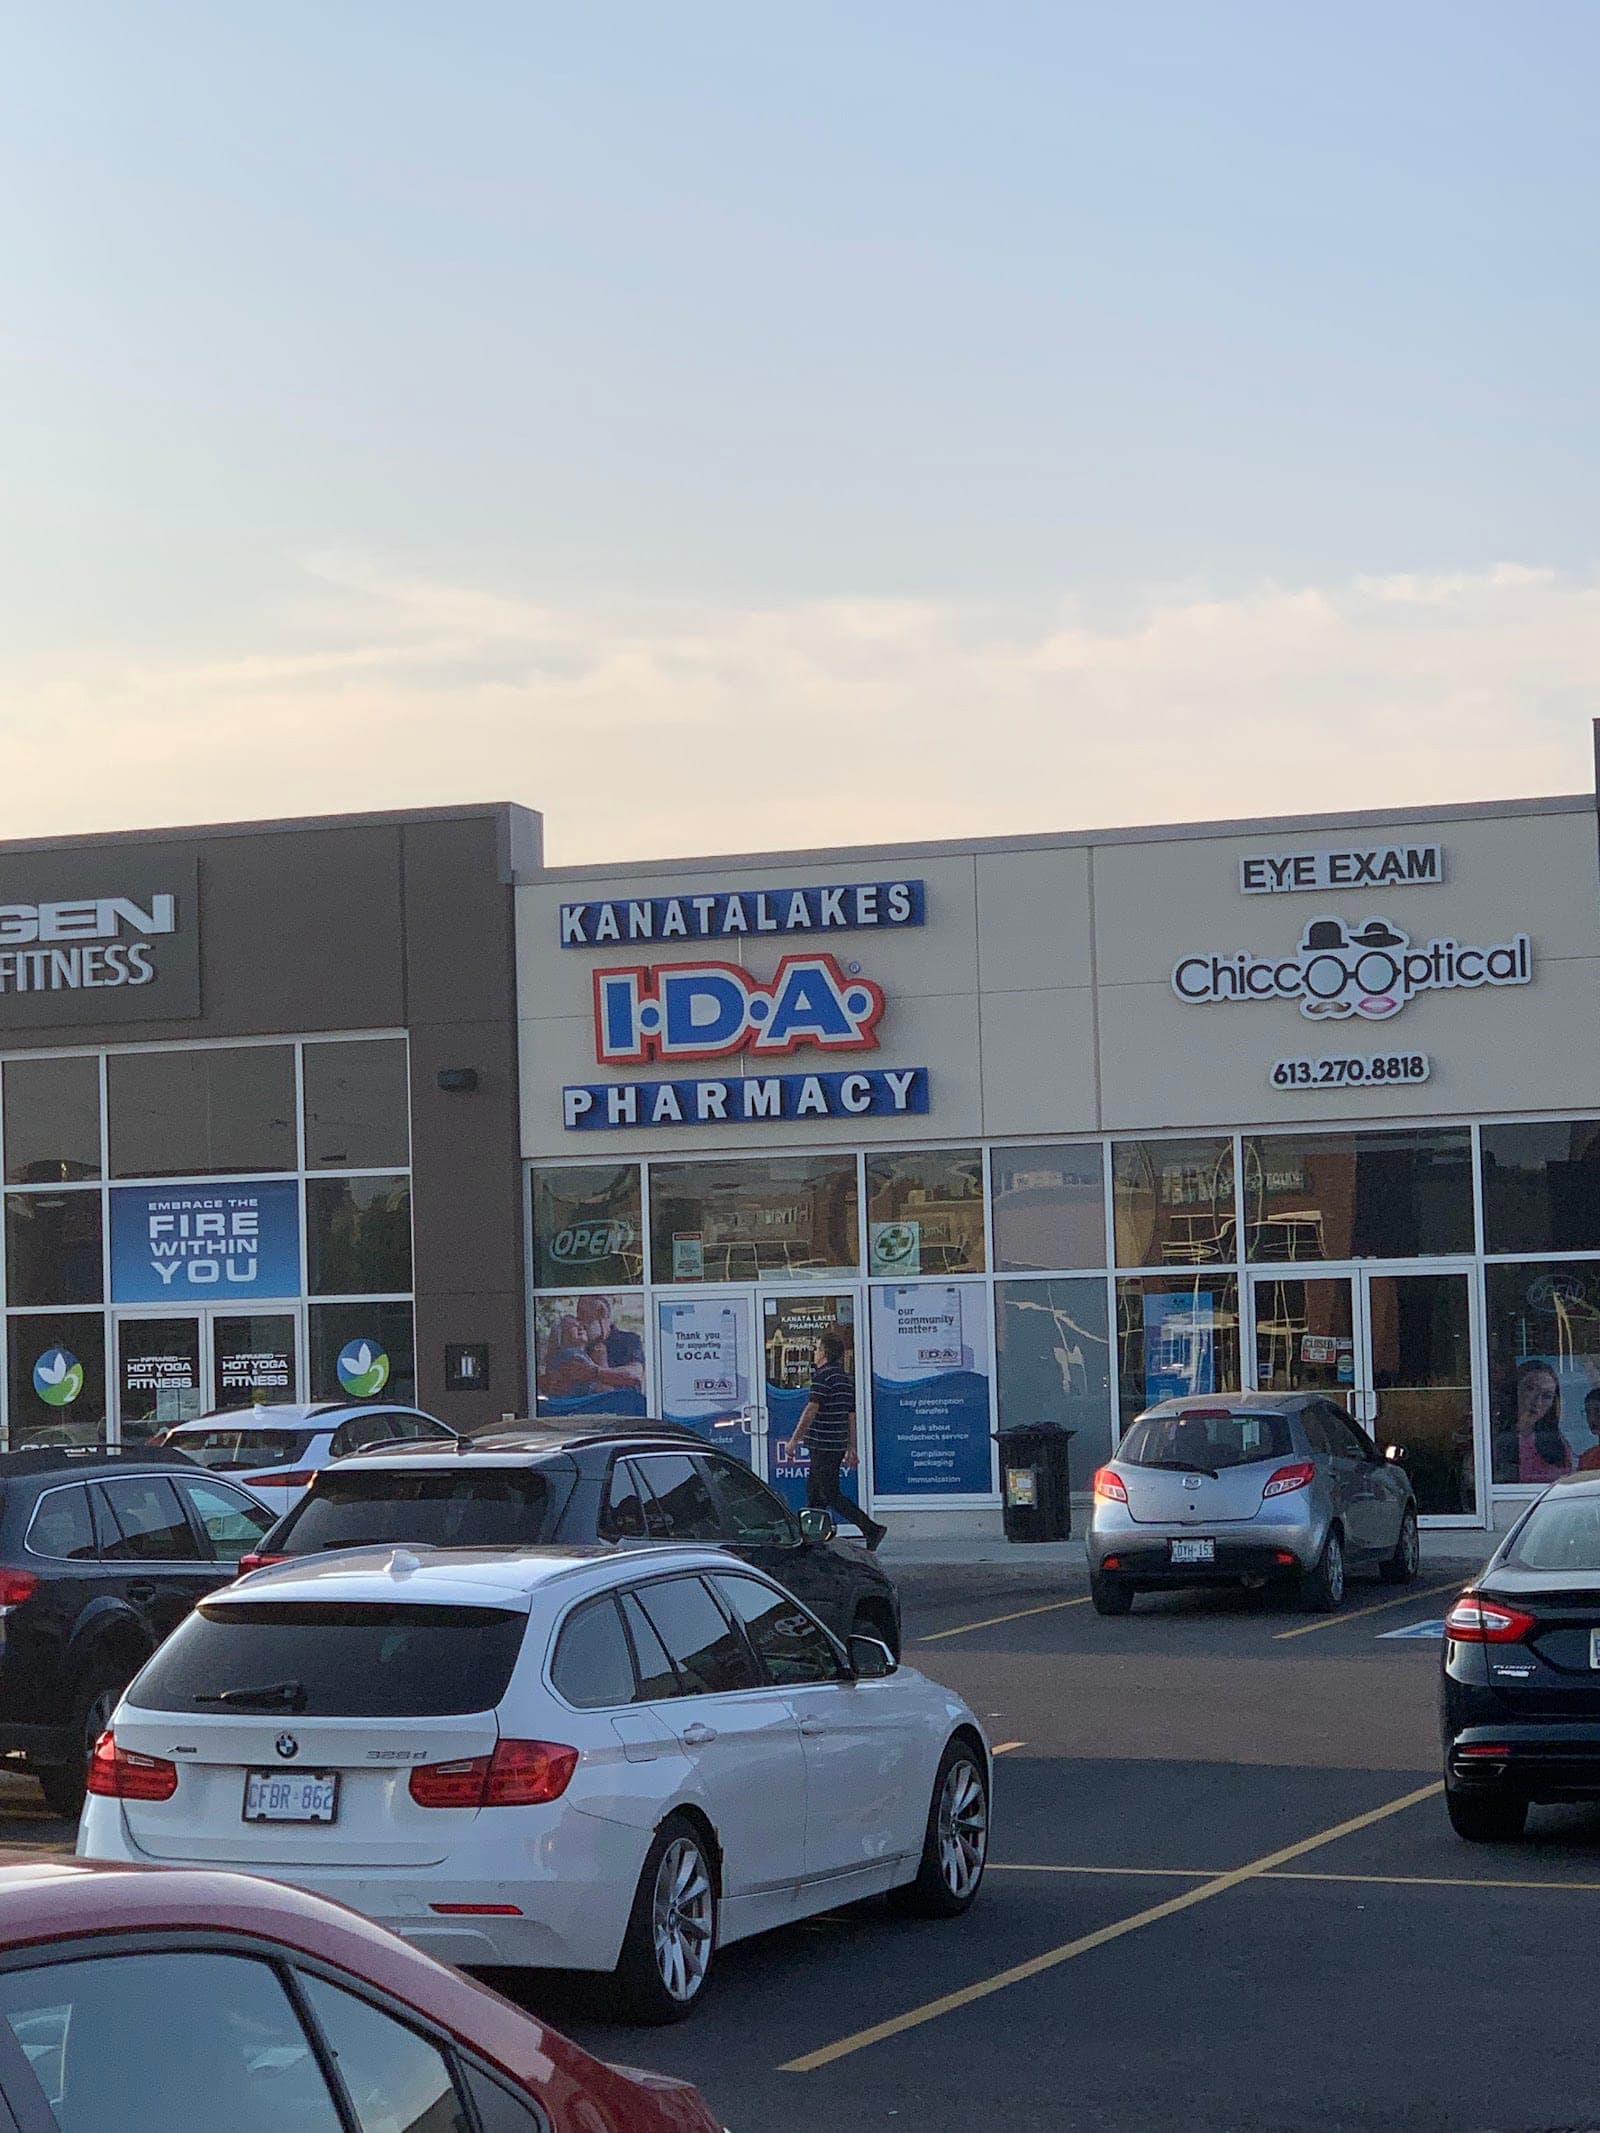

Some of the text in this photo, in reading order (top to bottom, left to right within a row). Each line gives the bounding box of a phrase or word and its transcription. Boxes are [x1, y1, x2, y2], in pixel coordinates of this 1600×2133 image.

[1243, 848, 1437, 889] EYE EXAM
[0, 942, 154, 993] FITNESS
[1273, 1055, 1425, 1085] 613.270.8818
[564, 1071, 915, 1127] PHARMACY
[148, 1198, 258, 1211] EMBRACE THE
[149, 1211, 259, 1239] FIRE
[150, 1239, 258, 1256] WITHIN
[553, 1228, 625, 1256] OPEN
[150, 1258, 257, 1284] YOU
[897, 1308, 914, 1316] our
[781, 1314, 837, 1323] KANATA LAKES
[898, 1314, 954, 1326] community
[789, 1322, 829, 1330] PHARMACY
[898, 1325, 938, 1335] matters
[675, 1331, 721, 1342] Thank you
[676, 1351, 721, 1361] LOCAL
[127, 1362, 192, 1373] HOT YOGA
[222, 1360, 288, 1370] HOT YOGA
[127, 1377, 193, 1389] FITNESS
[222, 1375, 289, 1387] FITNESS
[247, 1783, 334, 1811] CFBR 862
